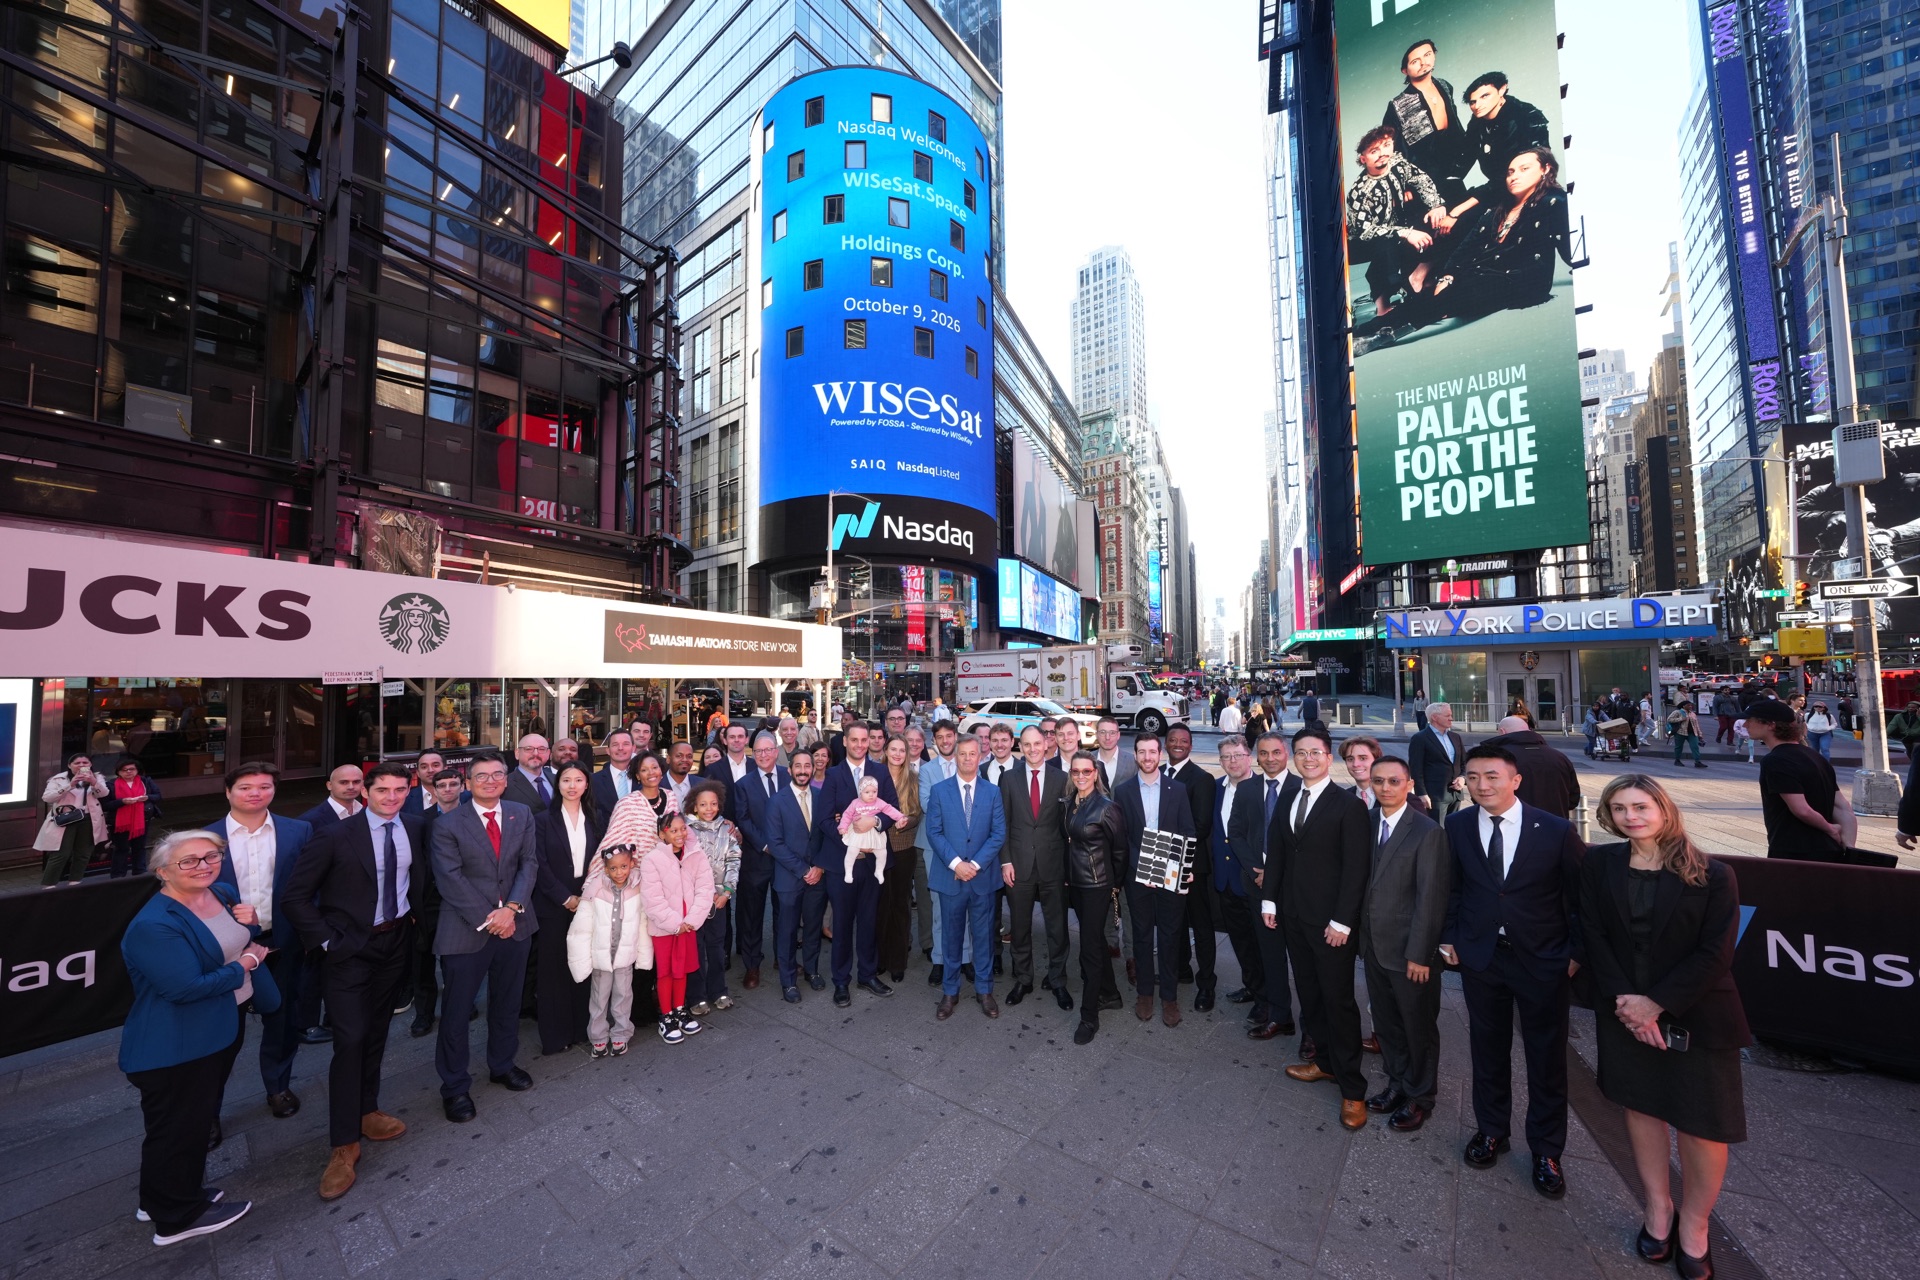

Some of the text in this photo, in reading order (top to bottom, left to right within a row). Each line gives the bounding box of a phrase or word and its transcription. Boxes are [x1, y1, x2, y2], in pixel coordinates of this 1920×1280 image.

[838, 120, 967, 172] Nasdaq Welcomes
[843, 172, 967, 222] WISeSat.Space
[1734, 150, 1754, 225] TV IS BETTER
[841, 234, 965, 279] Holdings Corp.
[843, 297, 961, 333] October 9, 2026
[1396, 363, 1527, 408] THE NEW ALBUM
[812, 381, 983, 438] WISeSat
[830, 418, 866, 427] Powered
[866, 419, 876, 427] by
[877, 418, 905, 428] FOSSA
[910, 422, 941, 435] Secured
[941, 428, 949, 438] by
[1397, 385, 1530, 445] PALACE
[850, 459, 960, 480] SAIQ NasdaqListed
[1395, 425, 1538, 484] FOR THE
[1400, 467, 1536, 521] PEOPLE
[883, 515, 974, 555] Nasdaq
[0, 566, 312, 642] UCKS
[1829, 583, 1888, 595] ONE WAY
[1324, 629, 1346, 638] NYC
[1386, 612, 1441, 638] NEW
[1444, 609, 1515, 635] YORK
[1523, 605, 1619, 633] POLICE
[1631, 598, 1719, 627] DEPT
[649, 633, 694, 648] TAMASHII
[760, 641, 778, 652] NEW
[778, 642, 797, 653] YORK
[0, 949, 96, 992] aq
[1766, 929, 1920, 988] Nas
